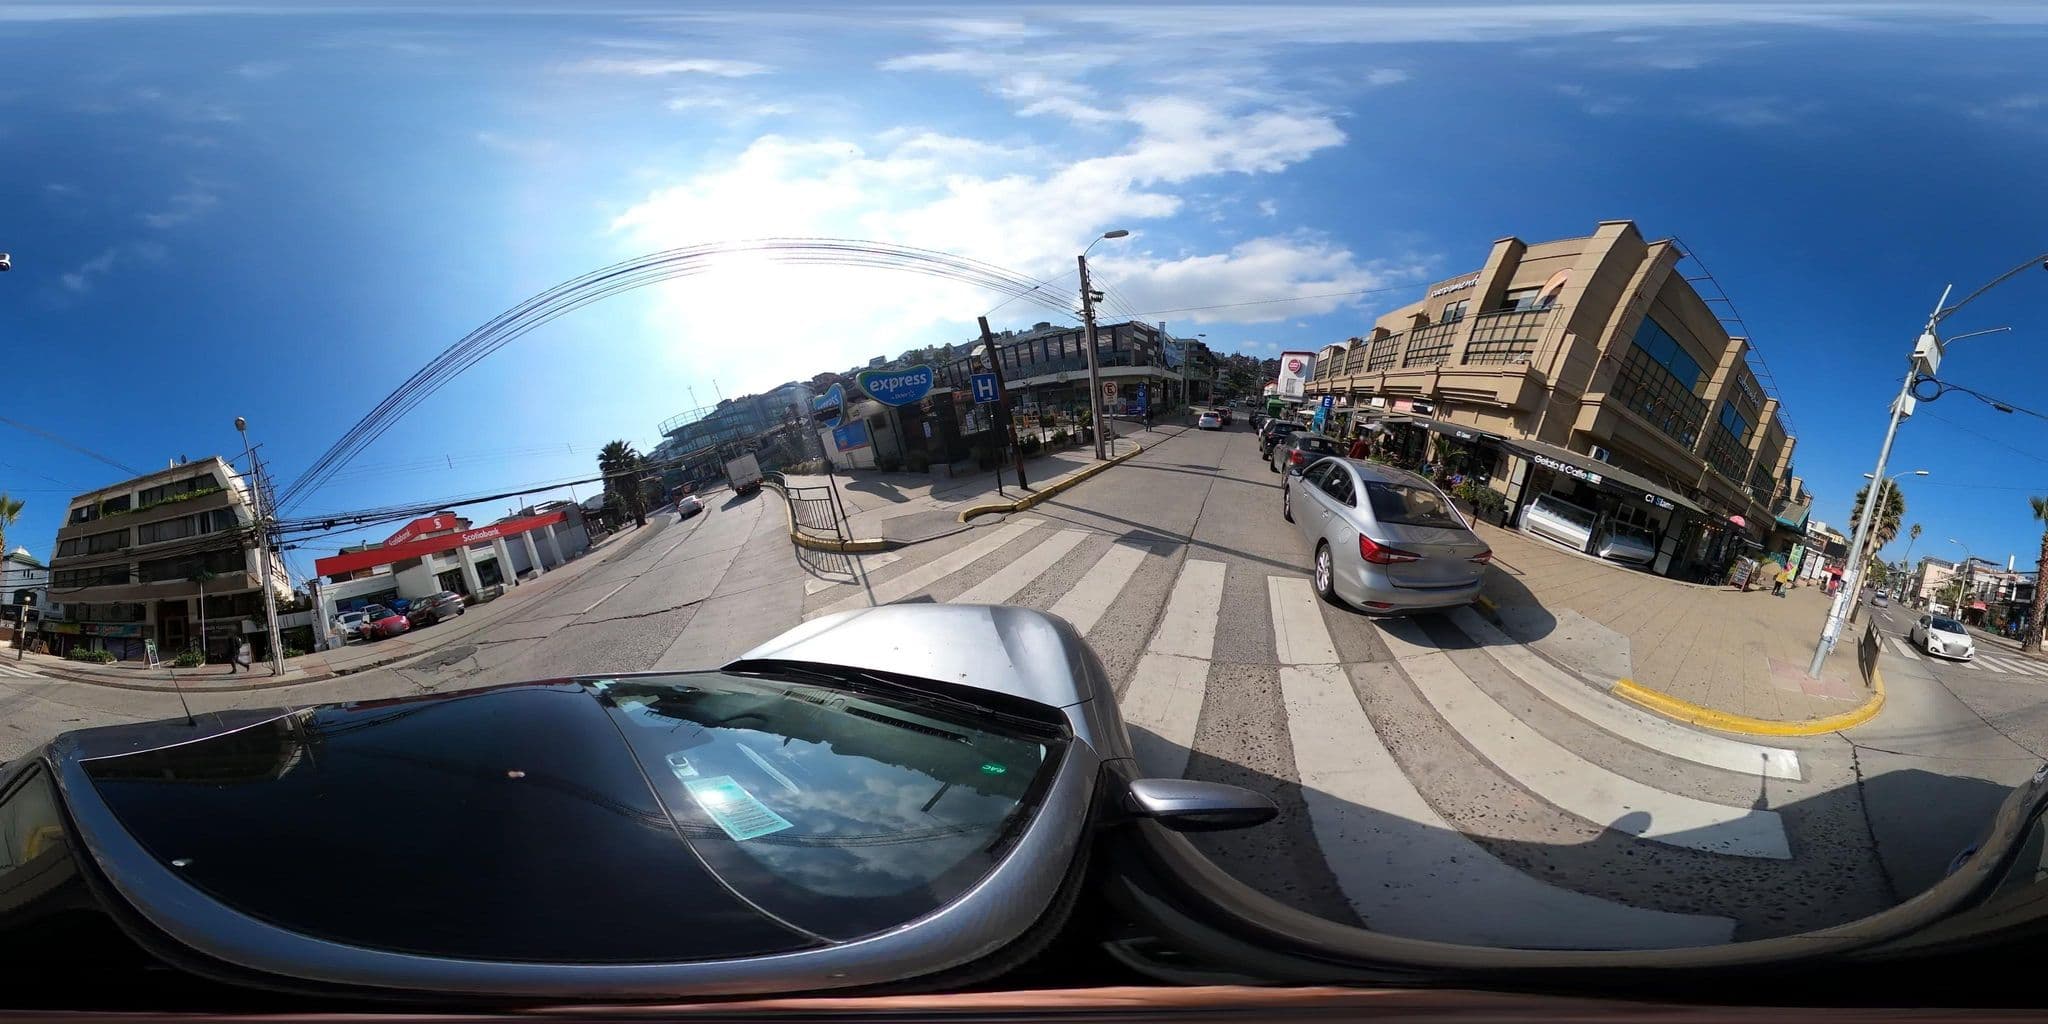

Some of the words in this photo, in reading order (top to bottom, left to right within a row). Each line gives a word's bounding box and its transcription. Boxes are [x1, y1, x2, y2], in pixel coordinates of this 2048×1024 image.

[870, 373, 927, 392] express
[977, 378, 994, 398] H
[1534, 455, 1559, 469] Gelato
[462, 528, 501, 543] Scotiabank
